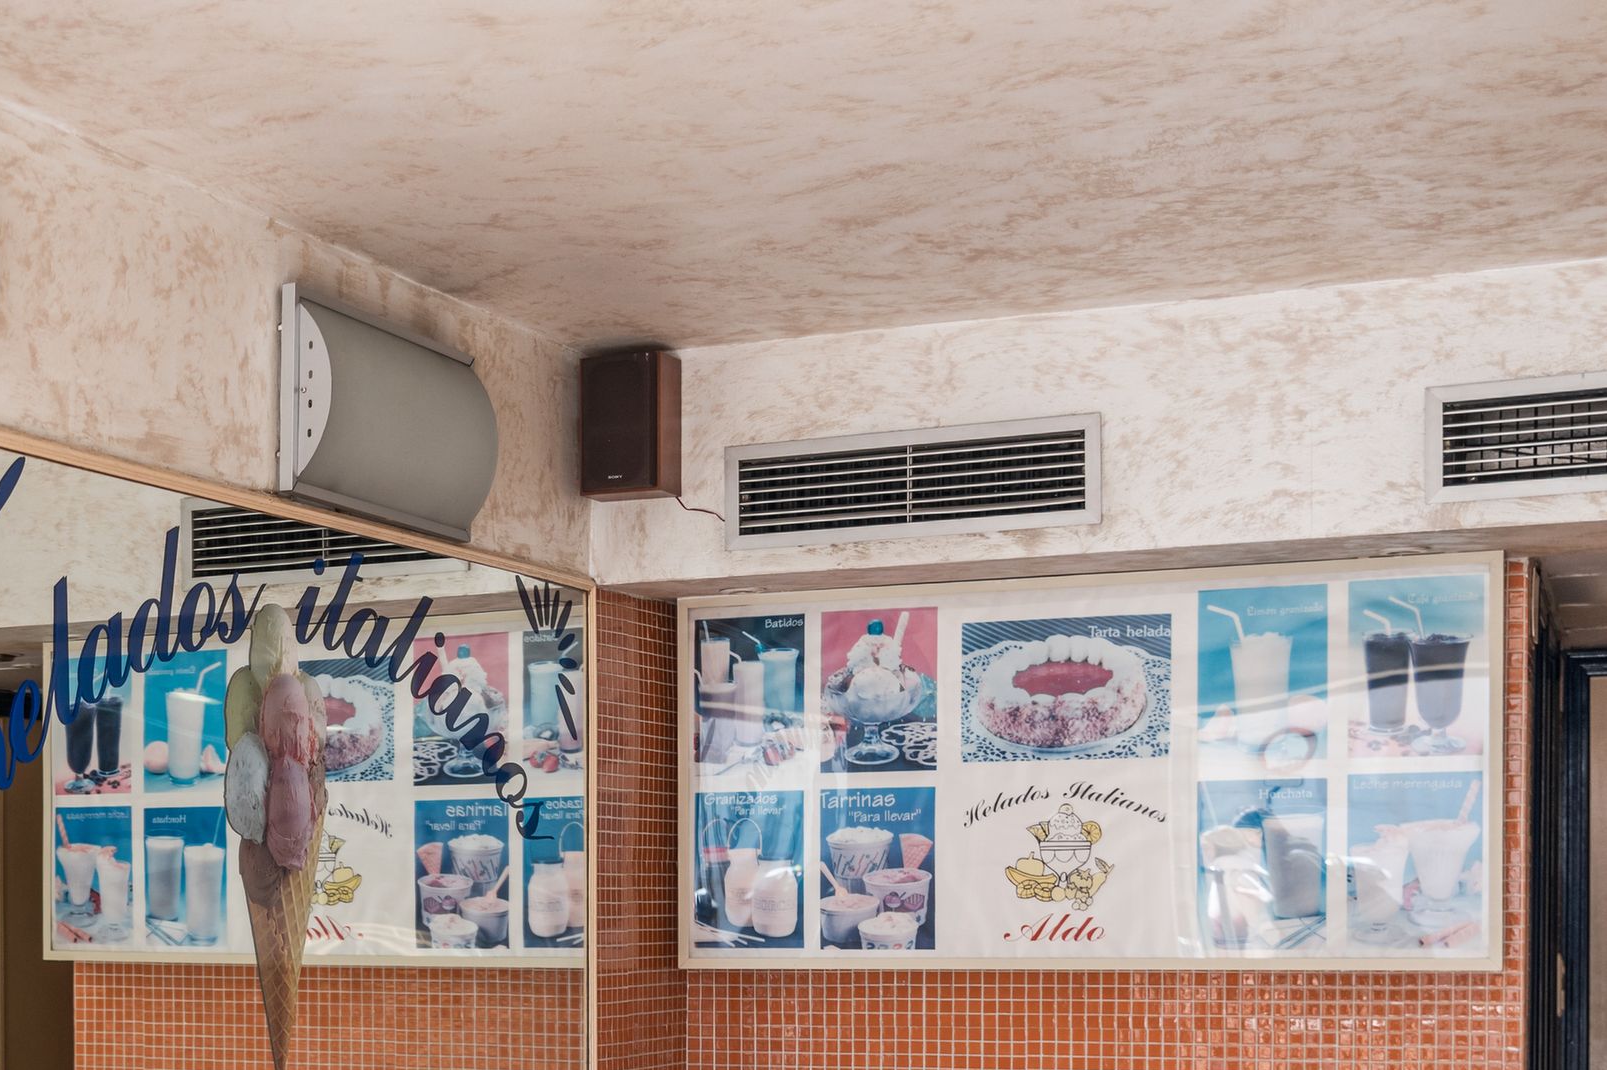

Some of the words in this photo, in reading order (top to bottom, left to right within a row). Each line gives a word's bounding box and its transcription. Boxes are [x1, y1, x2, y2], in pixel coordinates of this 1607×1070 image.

[764, 618, 804, 629] Batidos
[1088, 625, 1120, 638] Tarta
[1126, 625, 1171, 638] helada
[295, 552, 554, 840] italianos
[704, 791, 778, 805] Granizados
[819, 791, 896, 809] Tarrinas
[1258, 787, 1313, 800] Horchata
[963, 785, 1050, 828] Helados
[1063, 781, 1168, 823] Italianos
[848, 810, 880, 823] "Para
[884, 808, 922, 822] llevar"
[1003, 913, 1105, 942] Aldo
